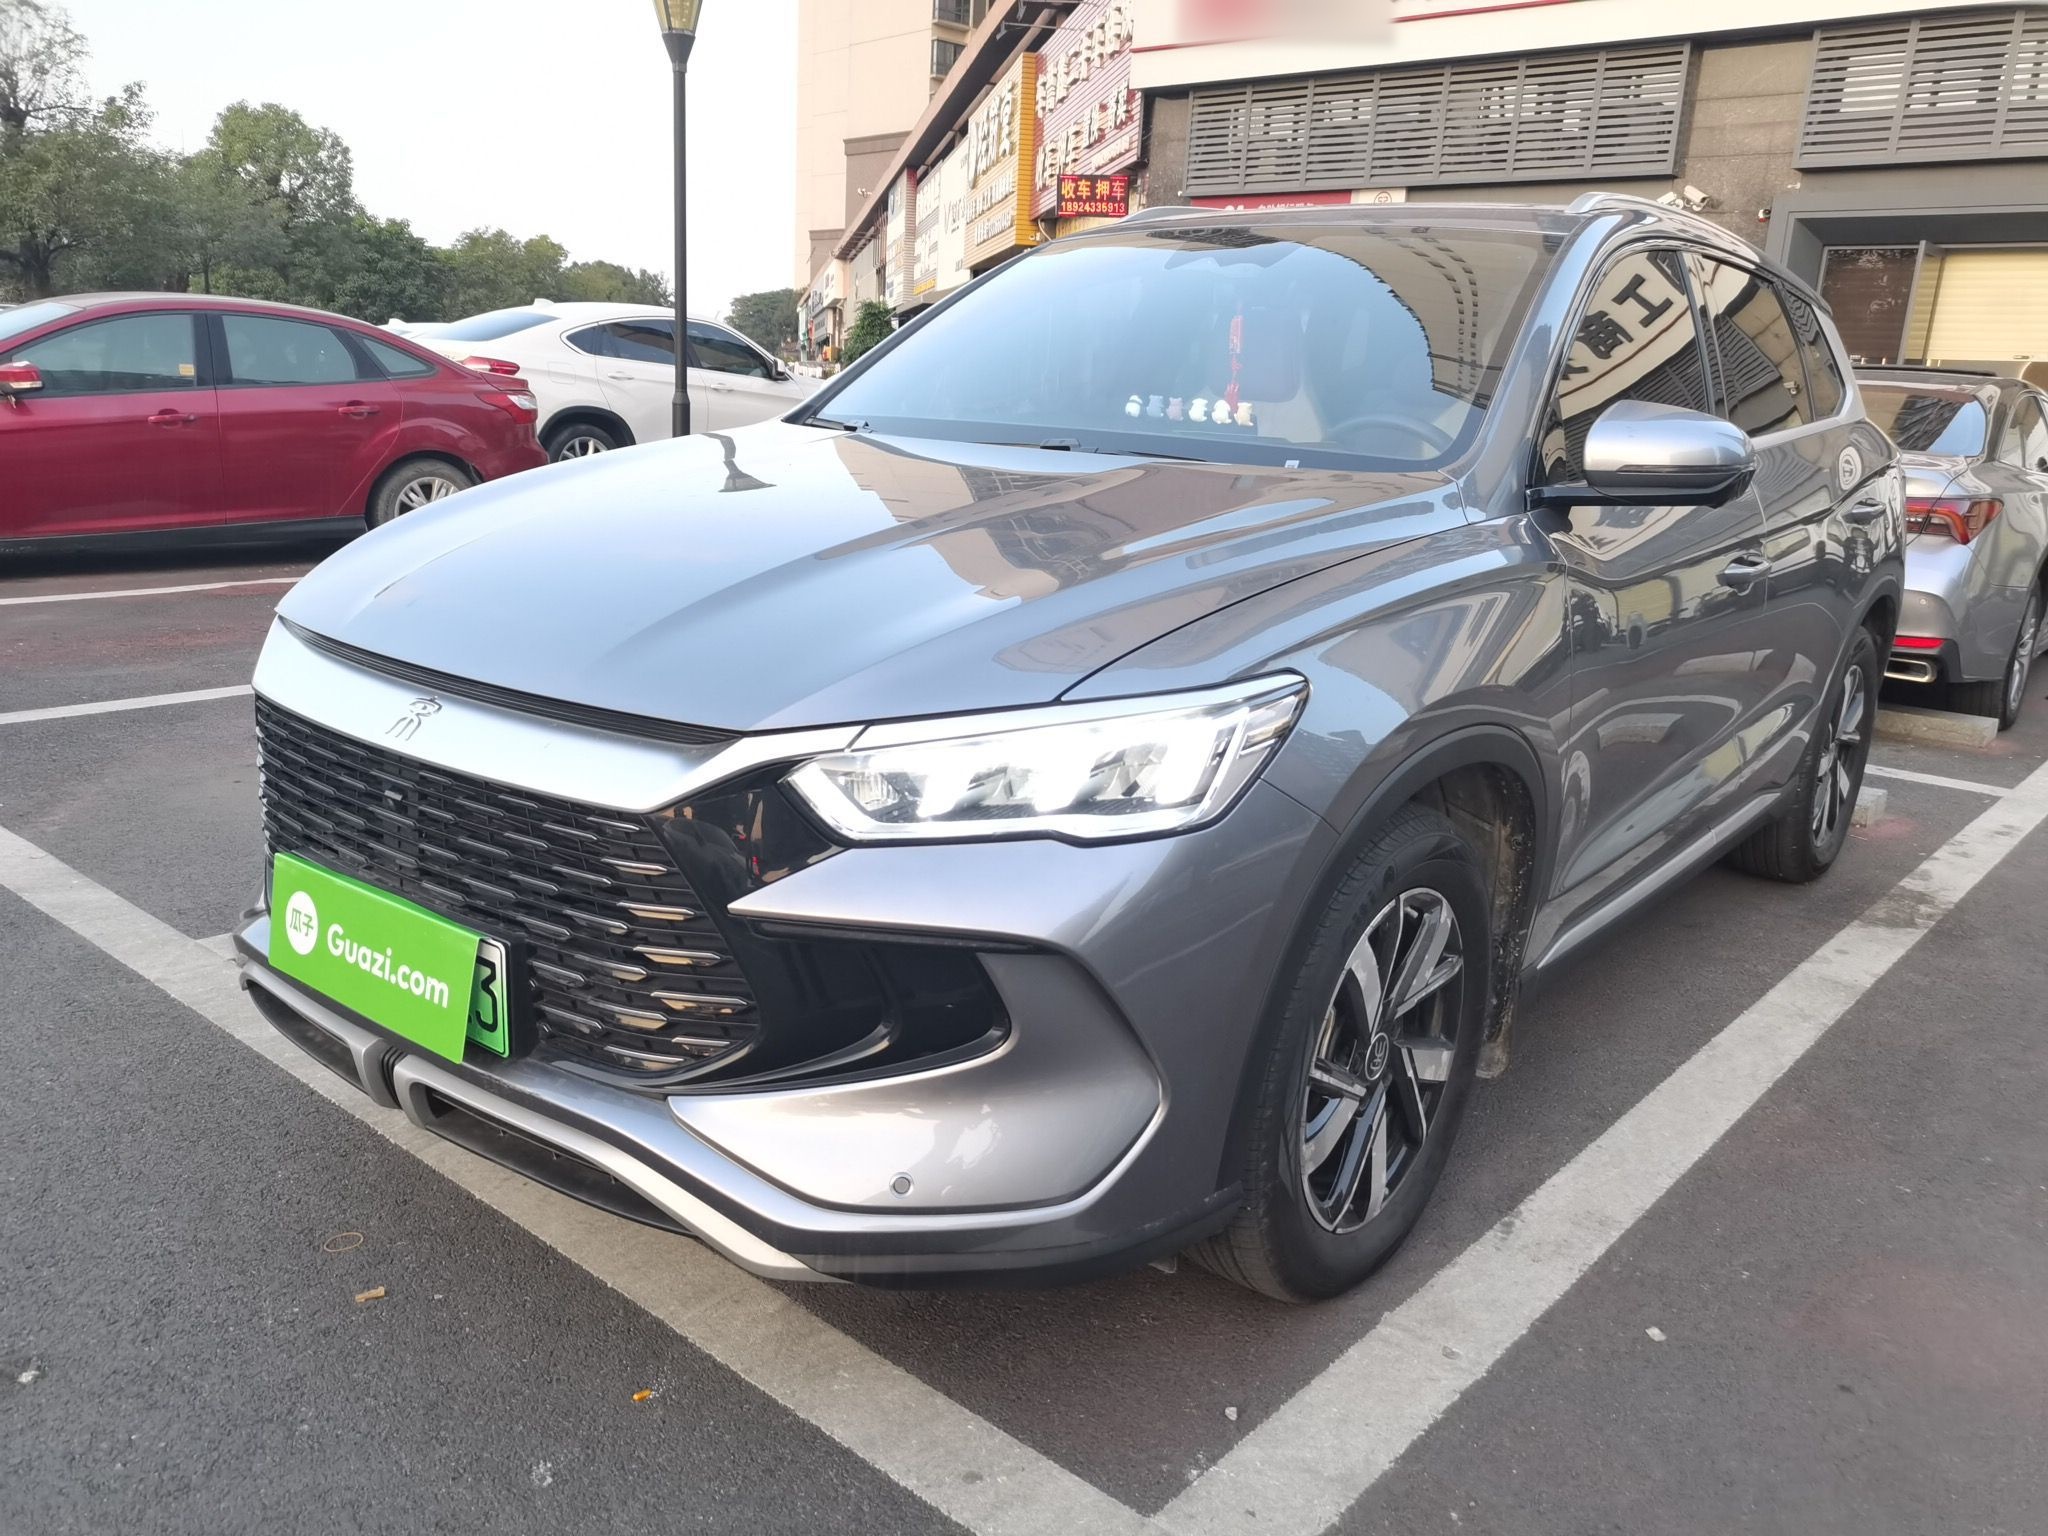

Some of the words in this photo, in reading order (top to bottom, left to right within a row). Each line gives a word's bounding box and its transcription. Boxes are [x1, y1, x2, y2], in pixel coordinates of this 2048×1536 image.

[1061, 179, 1091, 200] 收车
[1095, 179, 1125, 201] 押车
[289, 907, 315, 938] 瓜子
[326, 923, 449, 1009] Guazi.com
